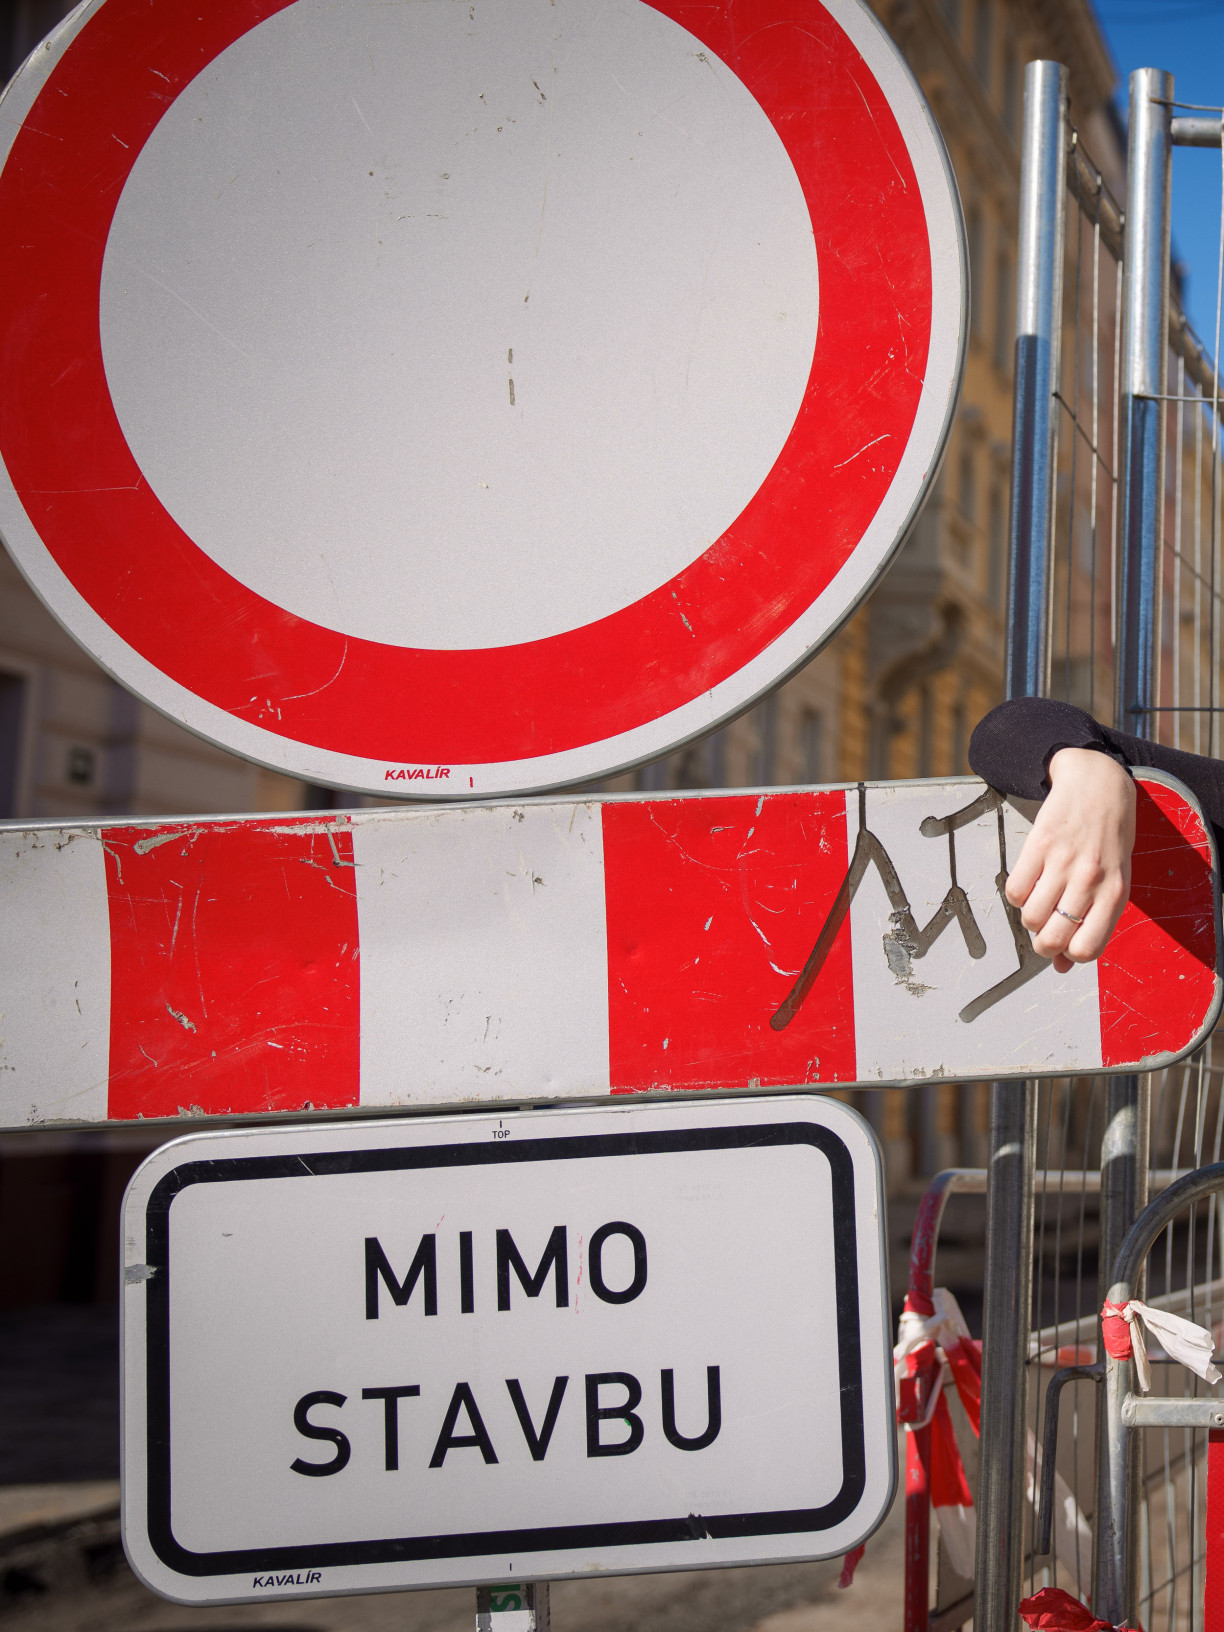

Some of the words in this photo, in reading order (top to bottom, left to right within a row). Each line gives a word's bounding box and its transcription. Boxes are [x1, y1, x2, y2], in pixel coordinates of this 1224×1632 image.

[385, 766, 450, 780] KAVALÍR
[492, 1130, 510, 1139] TOP
[365, 1221, 647, 1320] MIMO
[290, 1365, 722, 1477] STAVBU
[253, 1570, 321, 1588] KAVALÍR
